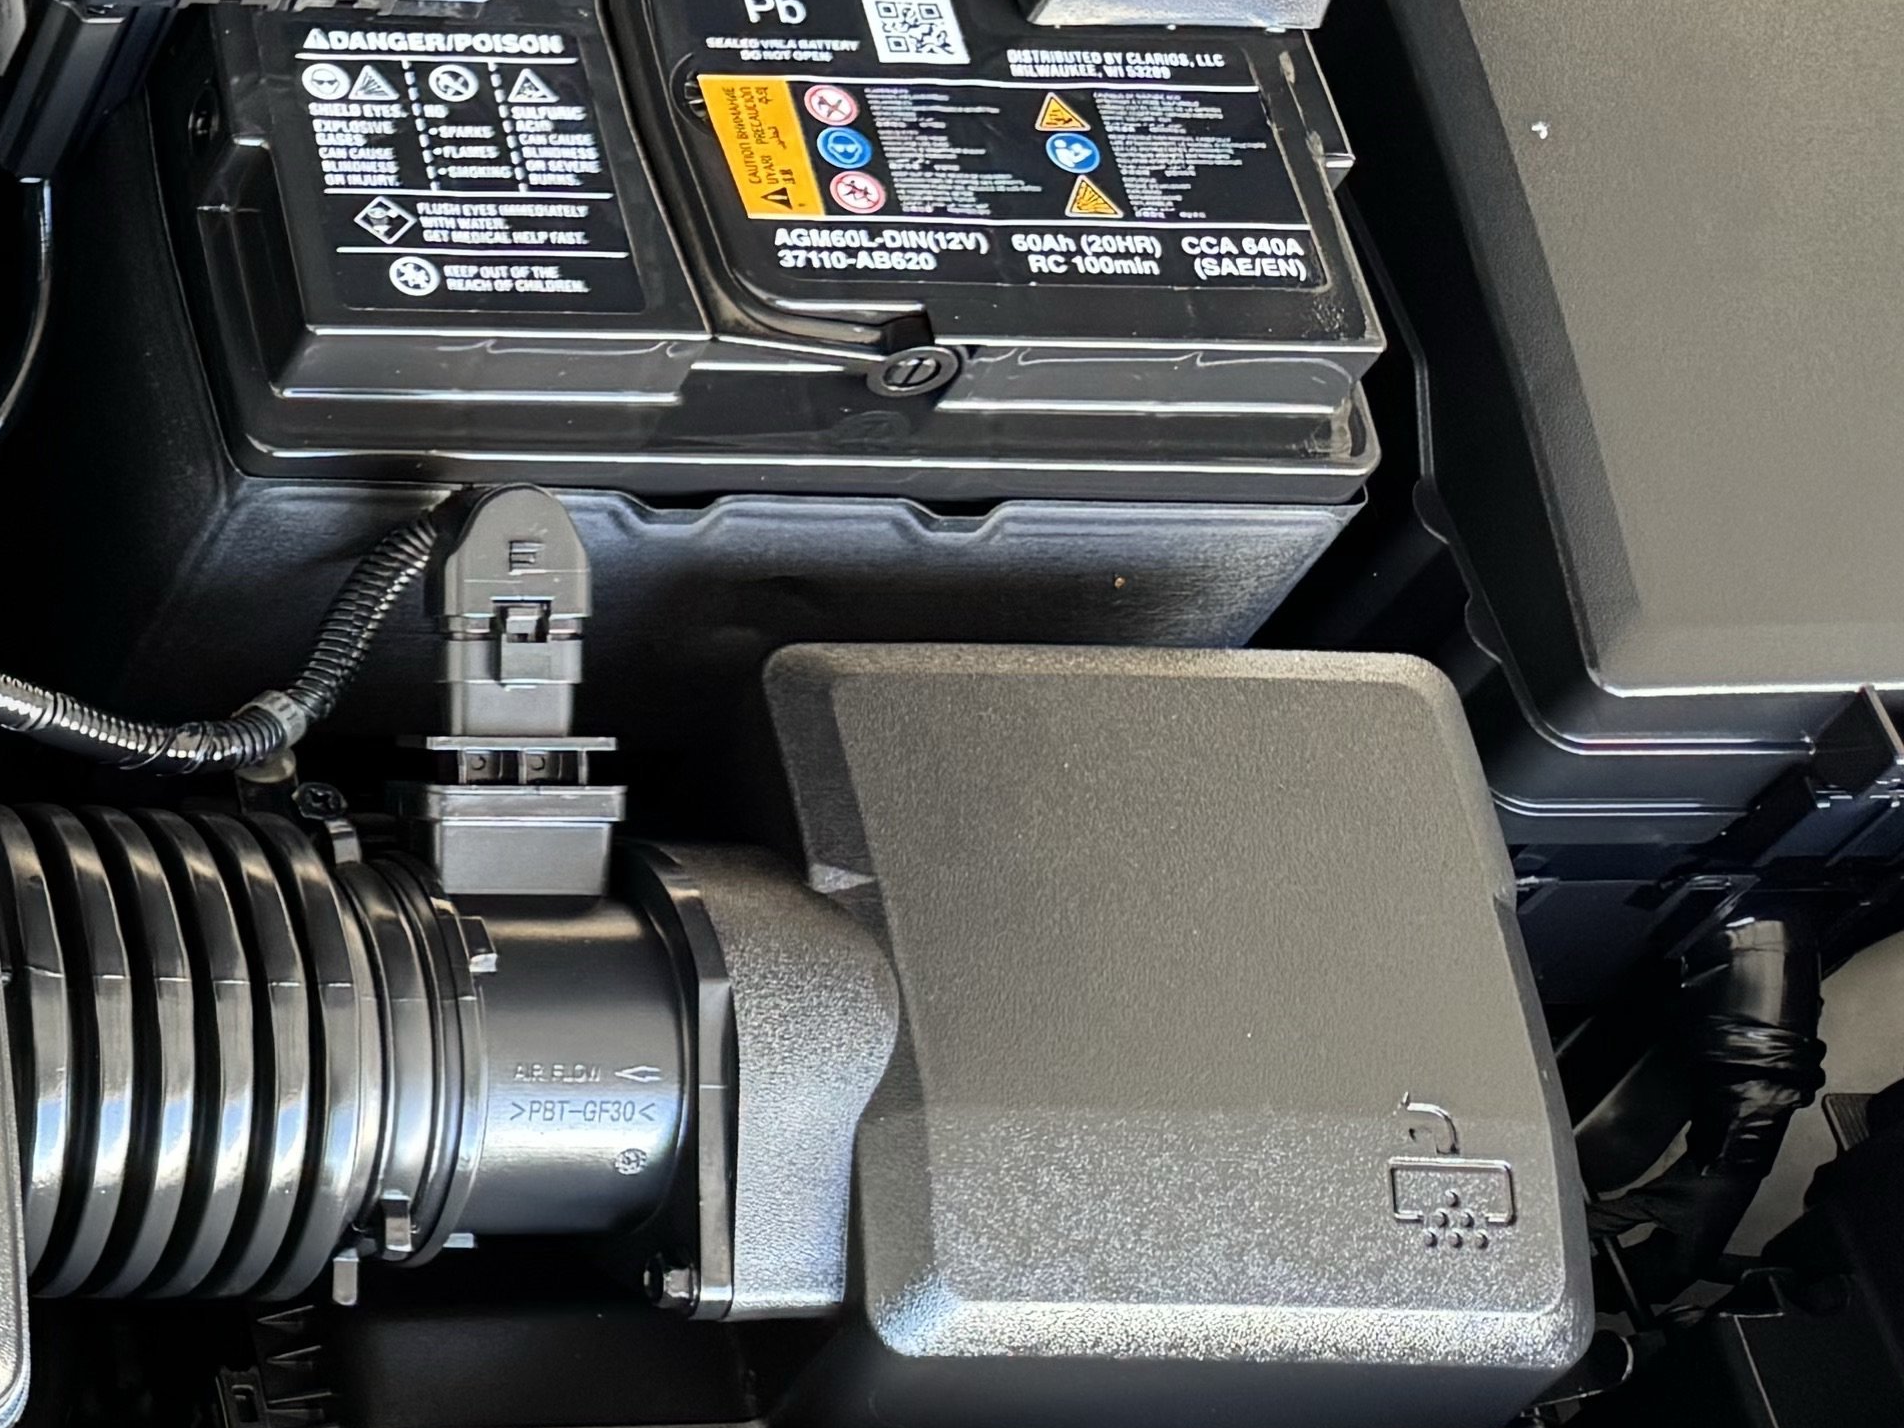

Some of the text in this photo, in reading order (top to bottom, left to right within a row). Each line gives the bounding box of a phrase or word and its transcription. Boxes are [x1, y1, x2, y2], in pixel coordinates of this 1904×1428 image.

[328, 31, 565, 54] DANGER/POISON
[706, 37, 759, 49] SEALED
[799, 39, 861, 51] BATTERY
[740, 50, 759, 61] DO
[761, 50, 791, 61] NOT
[1007, 49, 1225, 68] DISTRIBUTED BY CLARIOS, LLC
[1010, 64, 1103, 78] MILWAUKEE,
[1105, 66, 1125, 78] WI
[308, 103, 362, 116] SHIELD
[312, 119, 397, 134] EXPLOSIVE
[518, 133, 596, 146] CAN CAUSE
[318, 147, 395, 159] CAN CAUSE
[522, 146, 600, 159] BLINDNESS
[321, 160, 400, 173] BLINDNESS
[525, 160, 603, 173] OR SEVERE
[739, 142, 762, 185] CAUTION
[324, 174, 346, 186] OR
[416, 202, 589, 217] FLUSH EYES IMMEDIATELY
[419, 217, 456, 229] WITH
[423, 230, 450, 242] GET
[451, 230, 512, 244] MEDICAL
[512, 231, 548, 244] HELP
[775, 228, 1305, 258] AGM60L-DIN(12V) 60Ah (20HR) CCA 640A
[443, 265, 561, 279] KEEP OUT OF THE
[778, 250, 1307, 281] 37110-AB620 RC 100min (SAE/EN)
[446, 278, 493, 291] REACH
[494, 279, 513, 292] OF
[510, 1100, 656, 1123] >PBT-GF30<
